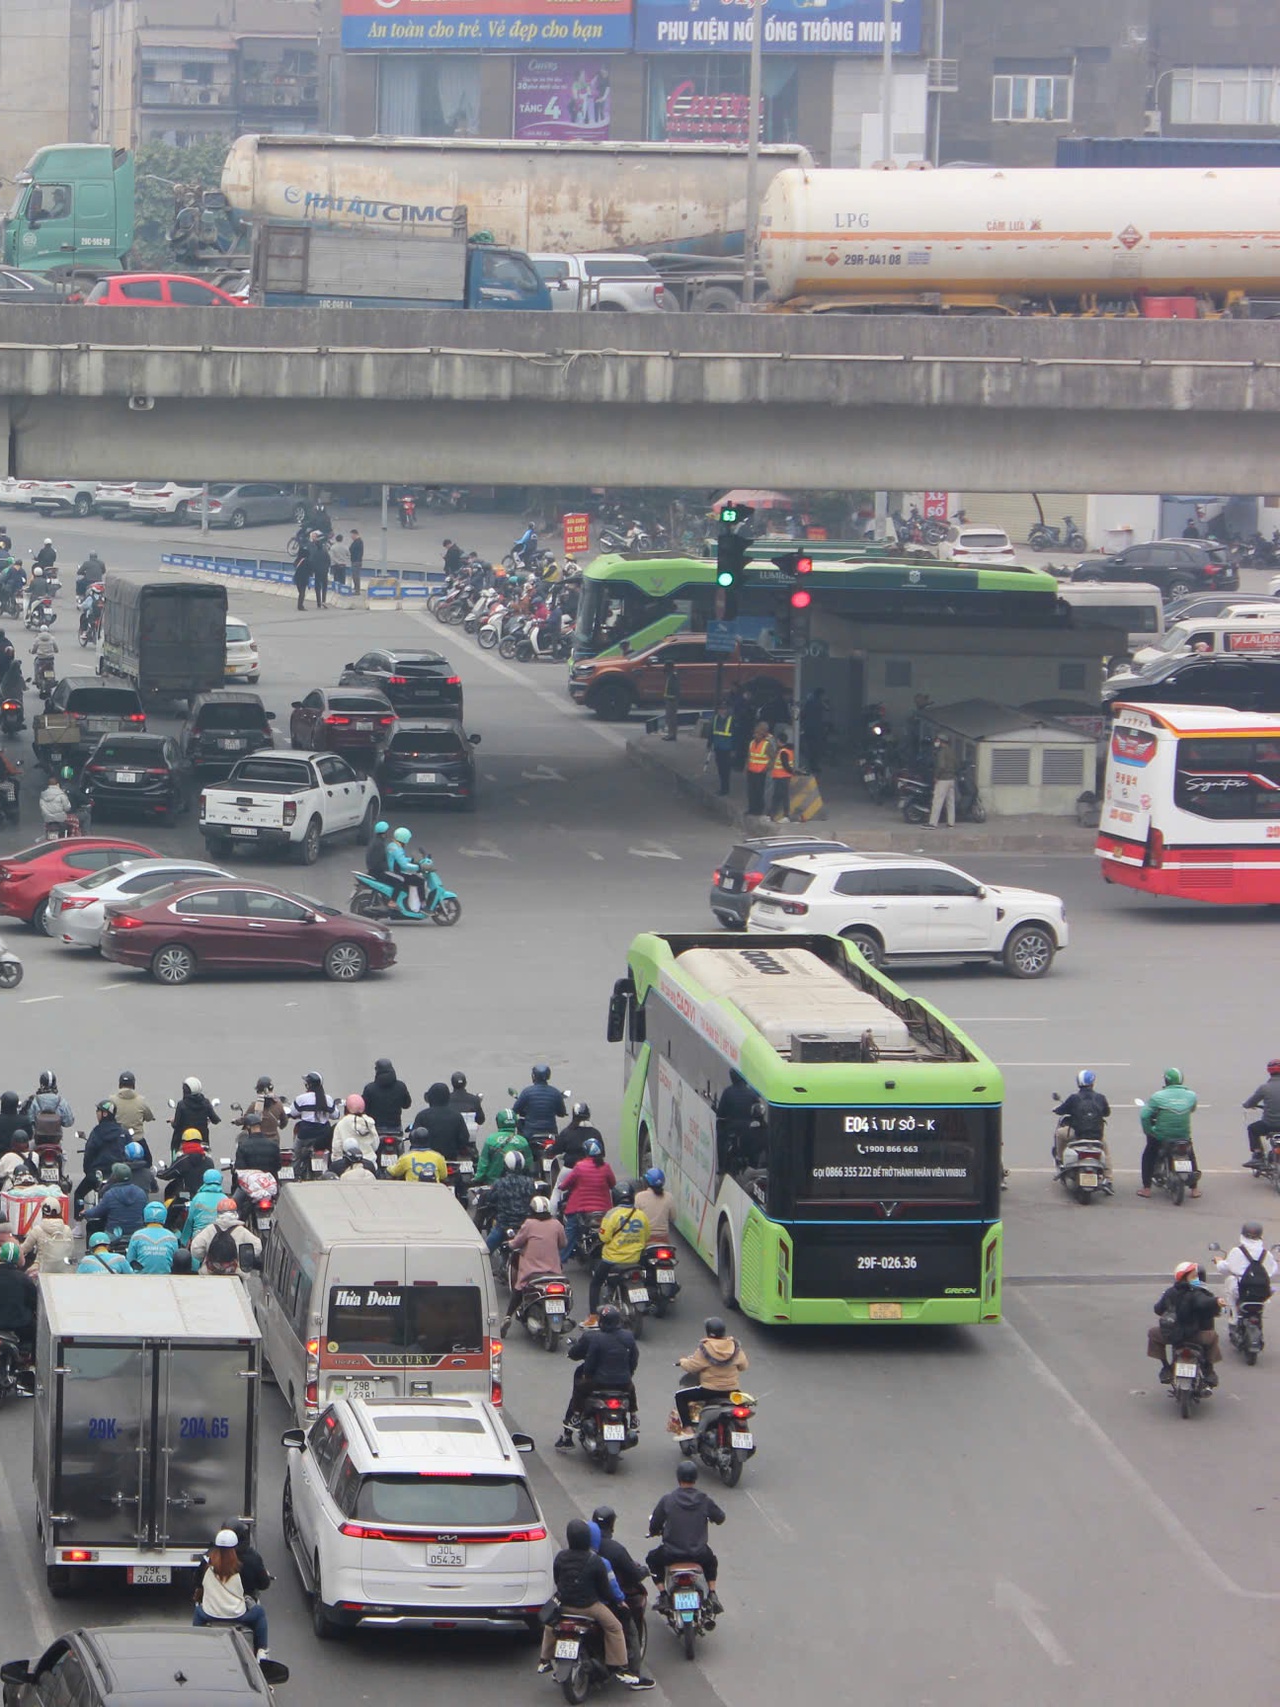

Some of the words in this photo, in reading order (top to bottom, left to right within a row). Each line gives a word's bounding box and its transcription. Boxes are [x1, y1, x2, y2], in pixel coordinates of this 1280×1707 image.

[367, 21, 387, 38] An
[391, 19, 424, 38] toàn
[428, 20, 454, 37] cho
[508, 19, 538, 41] đẹp
[541, 20, 567, 37] cho
[572, 19, 604, 41] bạn
[657, 20, 688, 45] PHỤ
[692, 17, 728, 45] KIỆN
[764, 15, 797, 42] ỐNG
[801, 17, 853, 42] THÔNG
[858, 21, 902, 42] MINH
[835, 213, 870, 228] LPG
[1185, 777, 1249, 793] Signature
[209, 812, 281, 823] RANGER
[845, 1117, 870, 1133] E04
[825, 1166, 843, 1177] 0866
[844, 1166, 857, 1177] 355
[858, 1166, 872, 1177] 222
[894, 1167, 914, 1177] THÀNH
[915, 1167, 931, 1177] NHÂN
[931, 1167, 945, 1177] VIÊN
[946, 1168, 967, 1177] VINBUS
[620, 1215, 643, 1233] be
[857, 1257, 918, 1269] 29F-026.36
[335, 1290, 362, 1306] Hứa
[366, 1290, 402, 1306] Đoàn
[376, 1355, 433, 1364] LUXURY
[354, 1382, 370, 1391] 29B
[180, 1417, 230, 1439] 204.65
[438, 1546, 455, 1555] 30L
[430, 1555, 462, 1565] 054.25
[144, 1566, 161, 1575] 29K
[137, 1575, 168, 1583] 204.65
